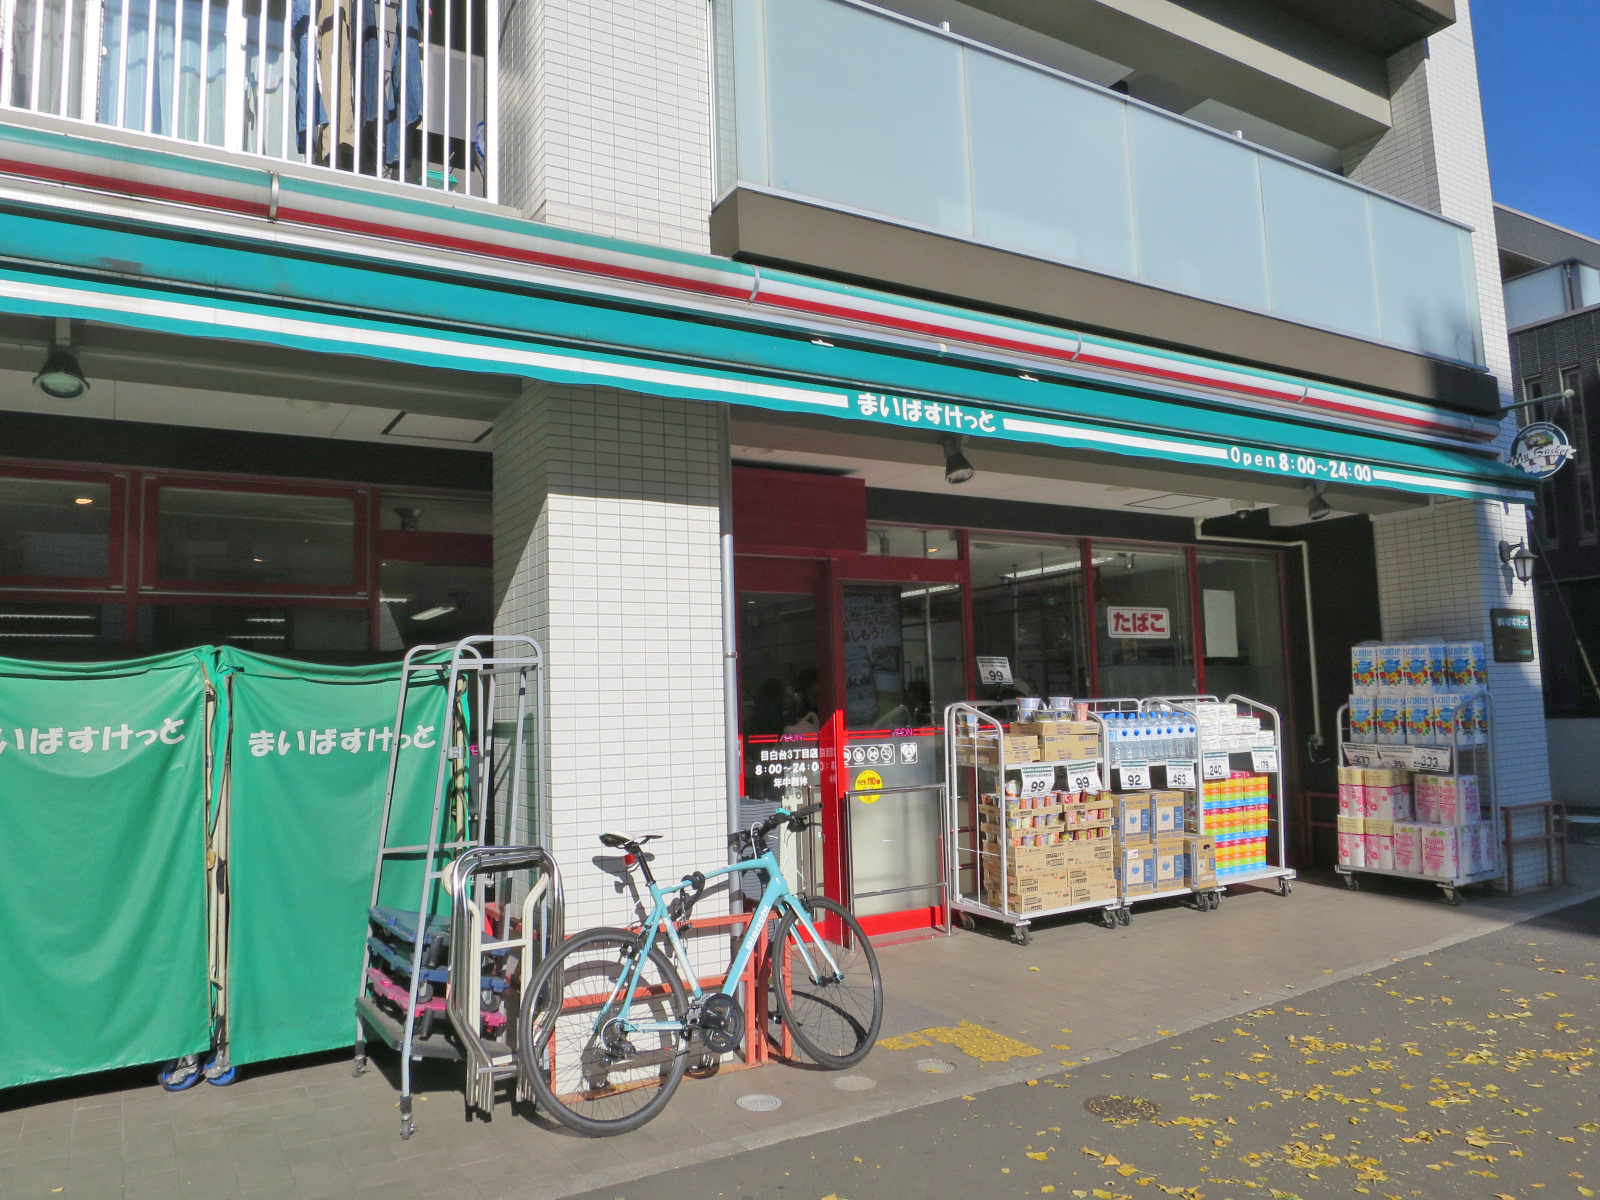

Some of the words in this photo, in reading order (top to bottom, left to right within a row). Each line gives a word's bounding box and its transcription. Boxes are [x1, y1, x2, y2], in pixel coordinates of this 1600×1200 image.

[857, 393, 998, 435] まいばすけっと
[1230, 446, 1276, 468] Open
[1508, 452, 1529, 466] My
[1113, 611, 1166, 633] たばこ
[989, 670, 1003, 681] 99
[249, 725, 436, 757] まいばすけっと
[761, 748, 818, 762] 目白台3丁目店
[1421, 756, 1438, 767] 333
[755, 761, 819, 776] 8:00~24:0
[1209, 765, 1222, 775] 240
[773, 776, 808, 788] 年中無休
[1075, 776, 1090, 789] 99
[1127, 774, 1141, 786] 92
[1173, 774, 1187, 785] 463
[1030, 780, 1045, 793] 99
[1425, 838, 1444, 846] Toilet
[1425, 844, 1445, 852] Paper
[745, 904, 769, 951] Bianchi
